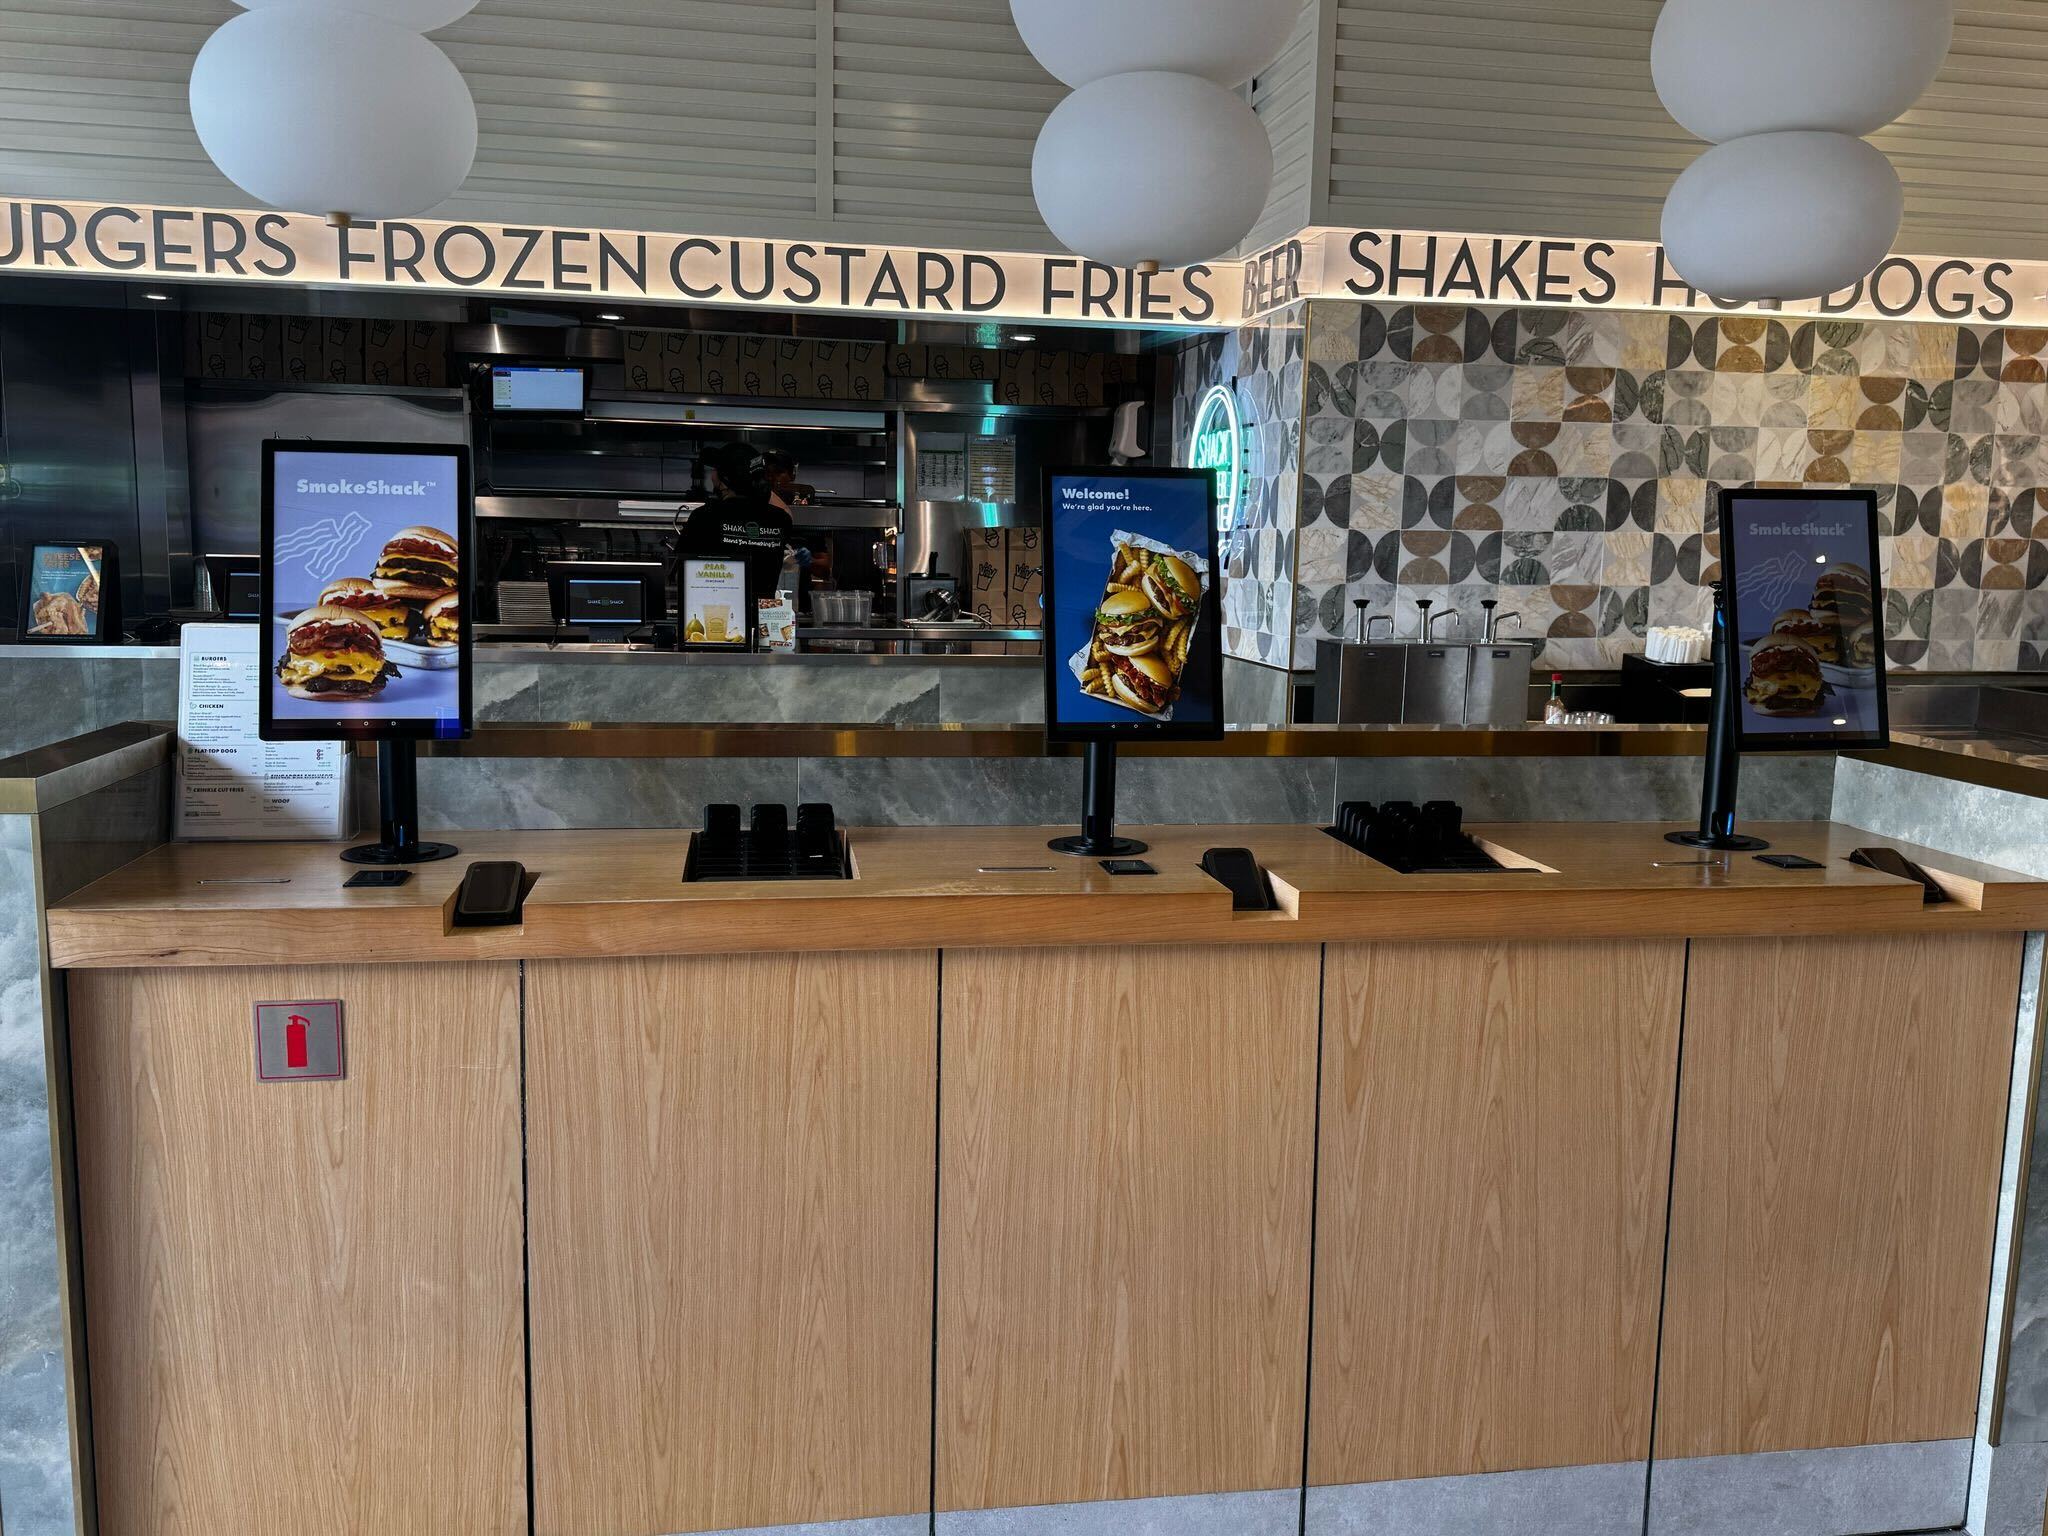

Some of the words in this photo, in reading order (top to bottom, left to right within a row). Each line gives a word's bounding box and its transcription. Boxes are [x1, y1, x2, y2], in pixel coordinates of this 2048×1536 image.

[338, 220, 647, 295] FROZEN
[669, 238, 1005, 312] CUSTARD
[1042, 258, 1214, 322] FRIES
[1241, 239, 1303, 319] BEER
[1345, 231, 1617, 305] SHAKES
[1061, 487, 1130, 500] Welcome!
[1087, 503, 1105, 512] glad
[1106, 504, 1131, 512] you're
